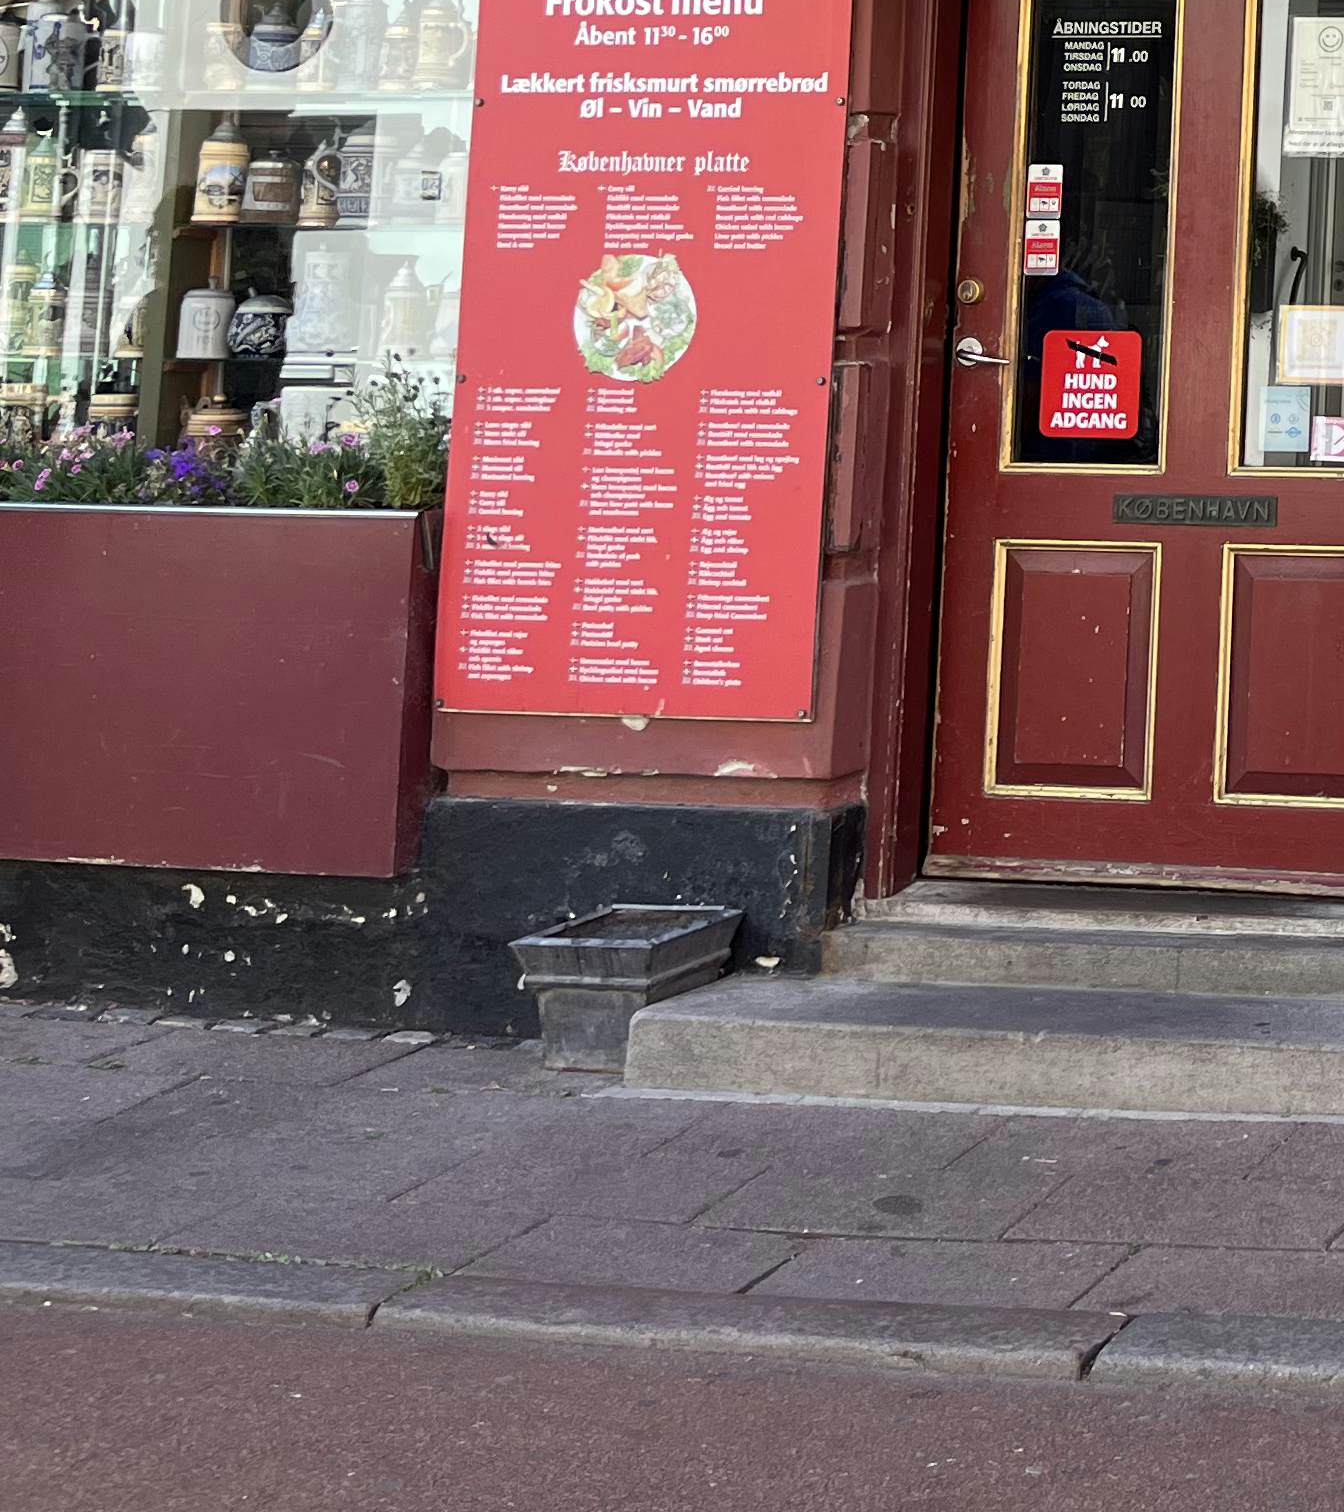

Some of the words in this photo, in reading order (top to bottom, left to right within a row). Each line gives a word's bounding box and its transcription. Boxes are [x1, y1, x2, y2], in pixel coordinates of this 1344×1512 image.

[574, 21, 636, 46] Åbent
[1053, 18, 1162, 35] ÅBNINGSTIDER
[1064, 41, 1104, 50] MANDAG
[1064, 52, 1103, 61] TIRSDAG
[1111, 47, 1125, 63] 11
[1063, 63, 1102, 72] ONSDAG
[501, 73, 585, 94] Lækkert
[589, 72, 698, 94] frisksmurt
[703, 72, 829, 93] smørrebrød
[1062, 81, 1100, 90] TORDAG
[579, 97, 603, 119] Øl
[628, 98, 662, 119] Vin
[687, 97, 742, 119] Vand
[1061, 103, 1099, 112] LØRDAG
[1062, 92, 1098, 101] FREDAG
[1109, 93, 1124, 109] 11
[1130, 96, 1147, 108] 00
[1061, 114, 1100, 123] SØNDAG
[558, 150, 686, 175] Københavner
[694, 150, 750, 176] platte
[1064, 373, 1118, 390] HUND
[1062, 392, 1118, 410] INGEN
[1051, 412, 1128, 430] ADGANG
[1118, 497, 1269, 521] KØBENHAVN
